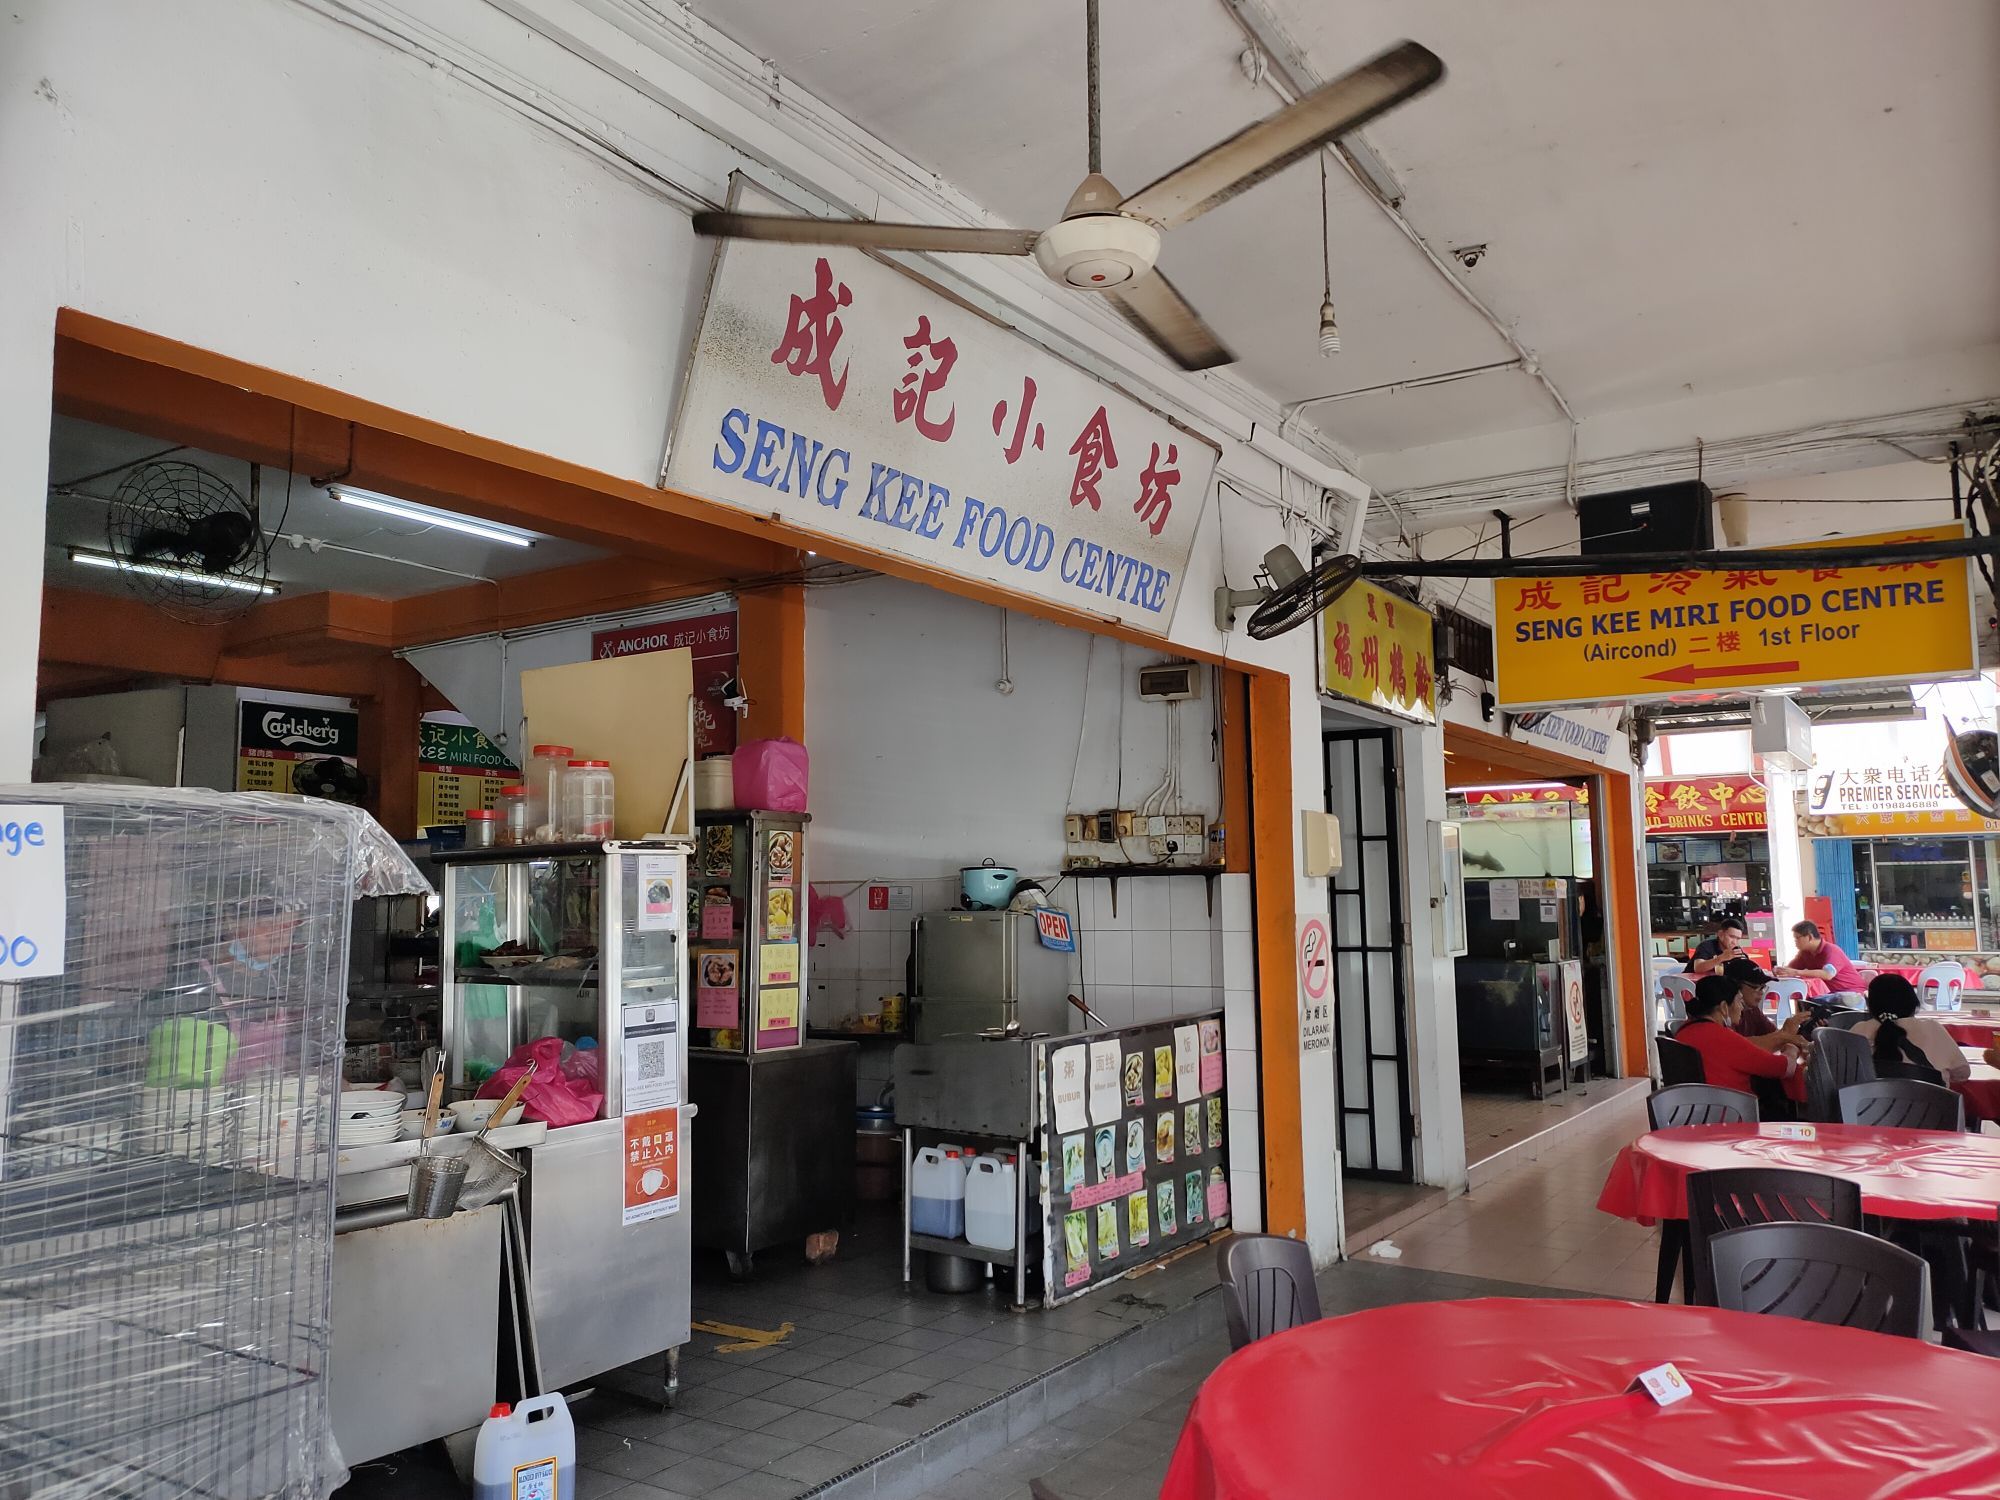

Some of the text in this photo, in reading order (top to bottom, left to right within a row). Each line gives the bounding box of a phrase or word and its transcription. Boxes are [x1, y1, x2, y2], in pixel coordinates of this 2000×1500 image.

[771, 257, 1181, 536] 成記小食坊
[712, 408, 1171, 614] SENG KEE FOOD CENTRE
[1515, 579, 1944, 643] SENG KEE MIRI FOOD CENTRE
[617, 625, 731, 654] ANCHOR 成记小食坊
[1583, 638, 1677, 662] (Aircond)
[1758, 626, 1791, 647] 1st
[1800, 623, 1860, 644] Floor
[262, 711, 339, 744] Carlsberg
[1560, 719, 1584, 746] FOOD
[449, 751, 472, 763] MIRI
[474, 753, 501, 765] FOOD
[1839, 786, 1893, 803] PREMIER
[1841, 803, 1861, 811] TEL
[1668, 814, 1713, 829] DRINKS
[0, 821, 45, 857] ge
[1039, 912, 1069, 940] OPEN
[1178, 1062, 1195, 1075] RICE
[1058, 1091, 1080, 1104] BUBUR
[1799, 1128, 1811, 1137] 10
[1666, 1371, 1680, 1388] 8
